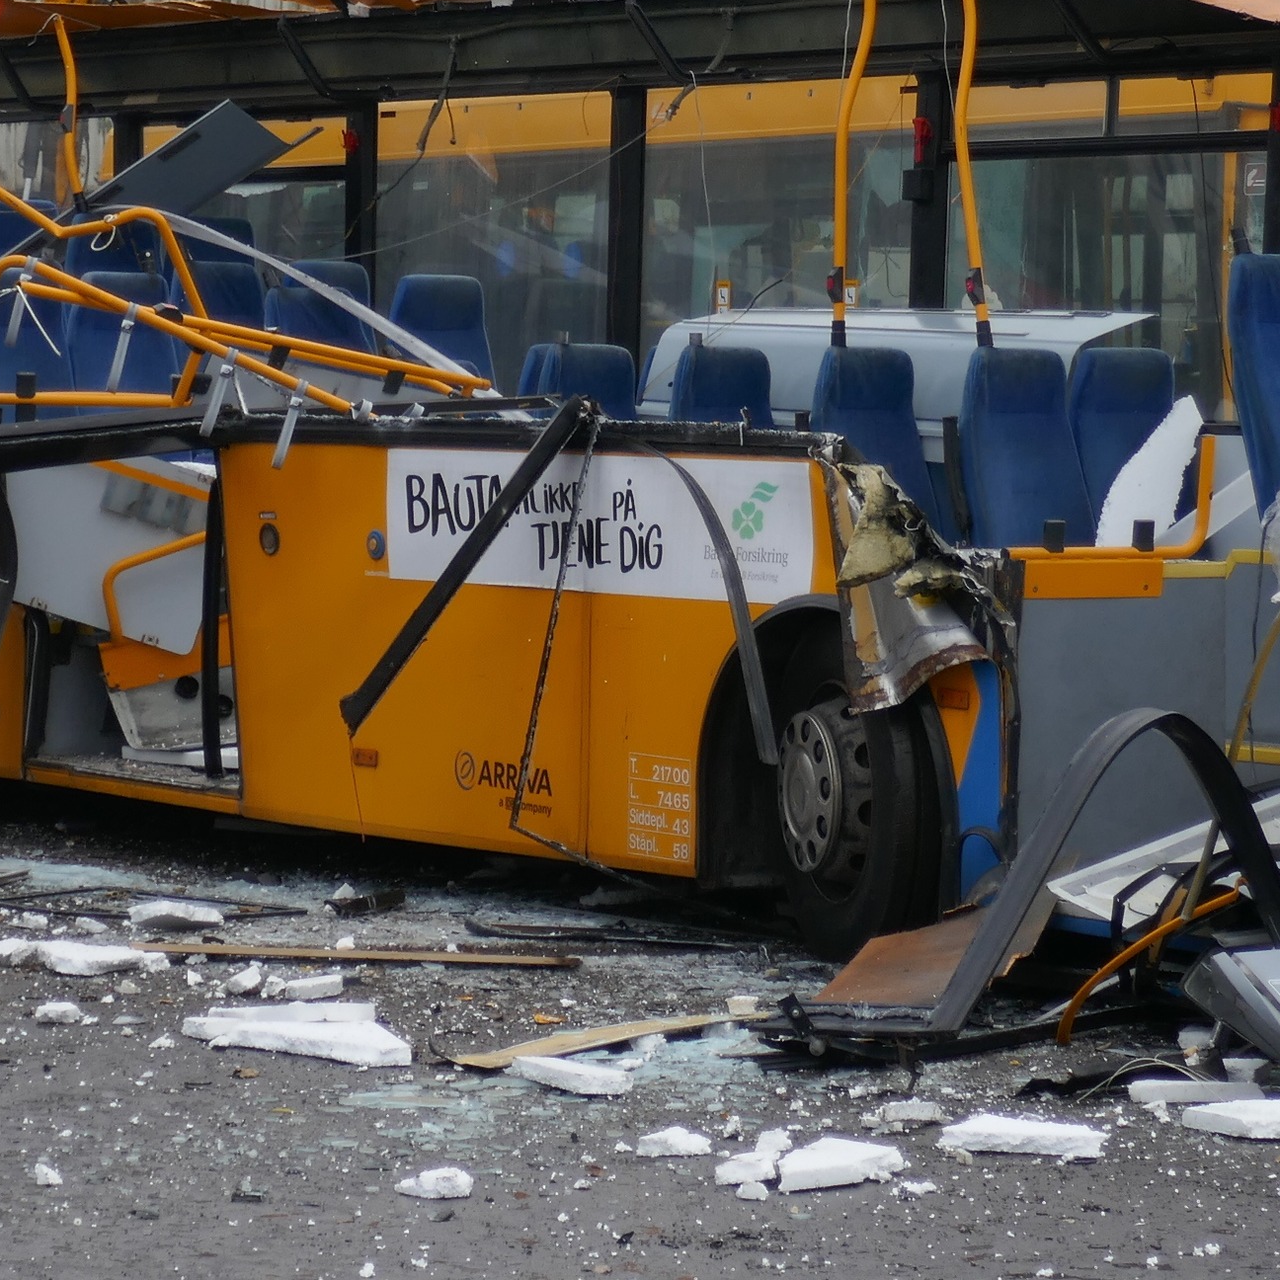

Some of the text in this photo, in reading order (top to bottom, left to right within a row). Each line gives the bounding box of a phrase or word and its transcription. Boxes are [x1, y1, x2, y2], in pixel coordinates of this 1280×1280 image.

[613, 478, 637, 522] PÅ
[735, 546, 789, 568] Forsikring
[478, 760, 553, 797] ARRVA
[630, 757, 689, 785] T. 21700
[518, 800, 552, 818] ompany
[630, 782, 690, 810] L. 7465
[629, 807, 689, 835] Siddepl. 43
[629, 832, 689, 859] Ståpl. 58
